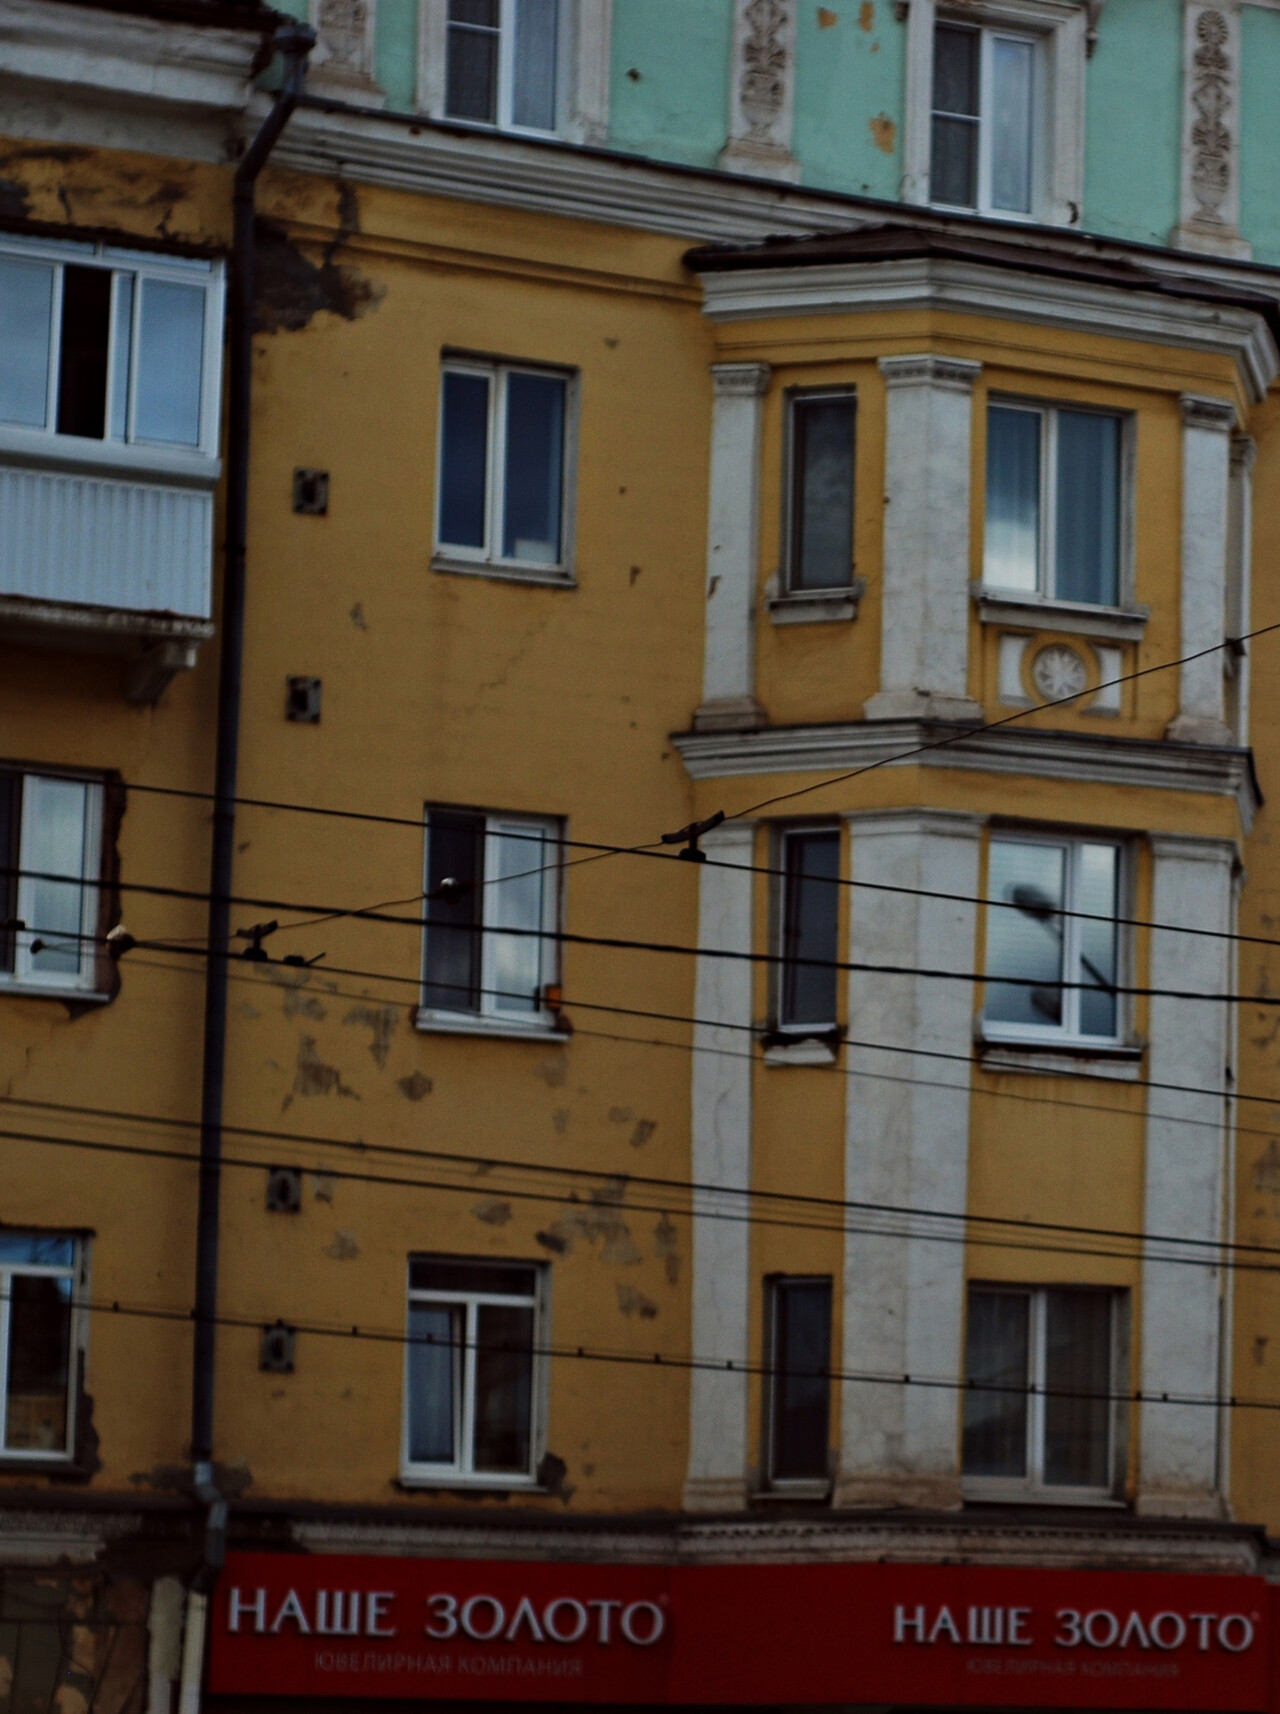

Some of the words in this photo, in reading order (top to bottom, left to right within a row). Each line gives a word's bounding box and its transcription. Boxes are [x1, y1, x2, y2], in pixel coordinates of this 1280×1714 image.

[227, 1586, 396, 1637] НАШЕ
[425, 1593, 665, 1646] ЗОЛОТО
[893, 1604, 1033, 1646] НАШЕ
[1054, 1608, 1255, 1653] ЗОЛОТО
[314, 1650, 452, 1674] ЮВЕЛИРНАЯ
[458, 1654, 583, 1678] КОМПАНИЯ
